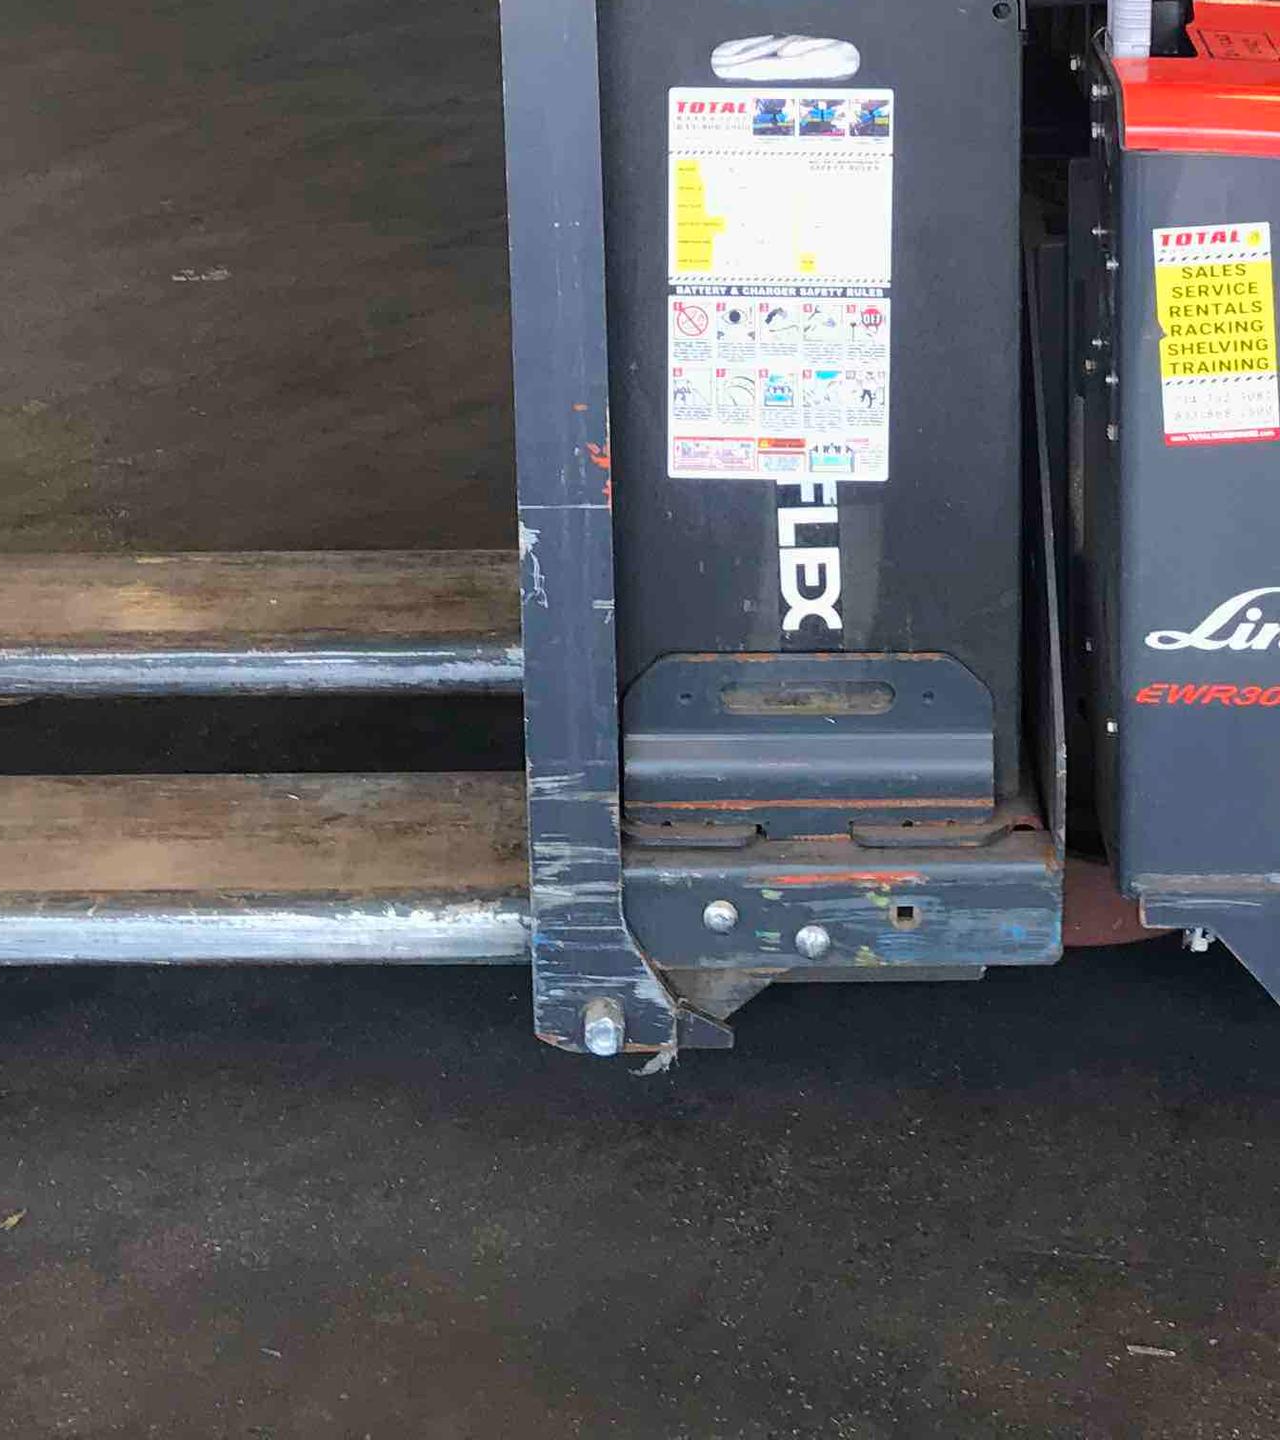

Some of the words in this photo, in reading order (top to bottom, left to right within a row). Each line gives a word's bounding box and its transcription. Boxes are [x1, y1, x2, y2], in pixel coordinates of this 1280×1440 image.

[677, 101, 747, 114] TOTAL
[1159, 230, 1240, 247] TOTAL
[1181, 263, 1246, 280] SALES
[676, 286, 727, 296] BATTERY
[730, 287, 738, 296] &
[742, 287, 797, 296] CHARGER
[800, 287, 844, 297] SAFETY
[846, 288, 884, 297] RULES
[1172, 282, 1259, 299] SERVICE
[1169, 300, 1263, 318] RENTALS
[1170, 319, 1264, 337] RACKING
[1167, 338, 1269, 356] SHELVING
[1169, 357, 1269, 375] TRAINING
